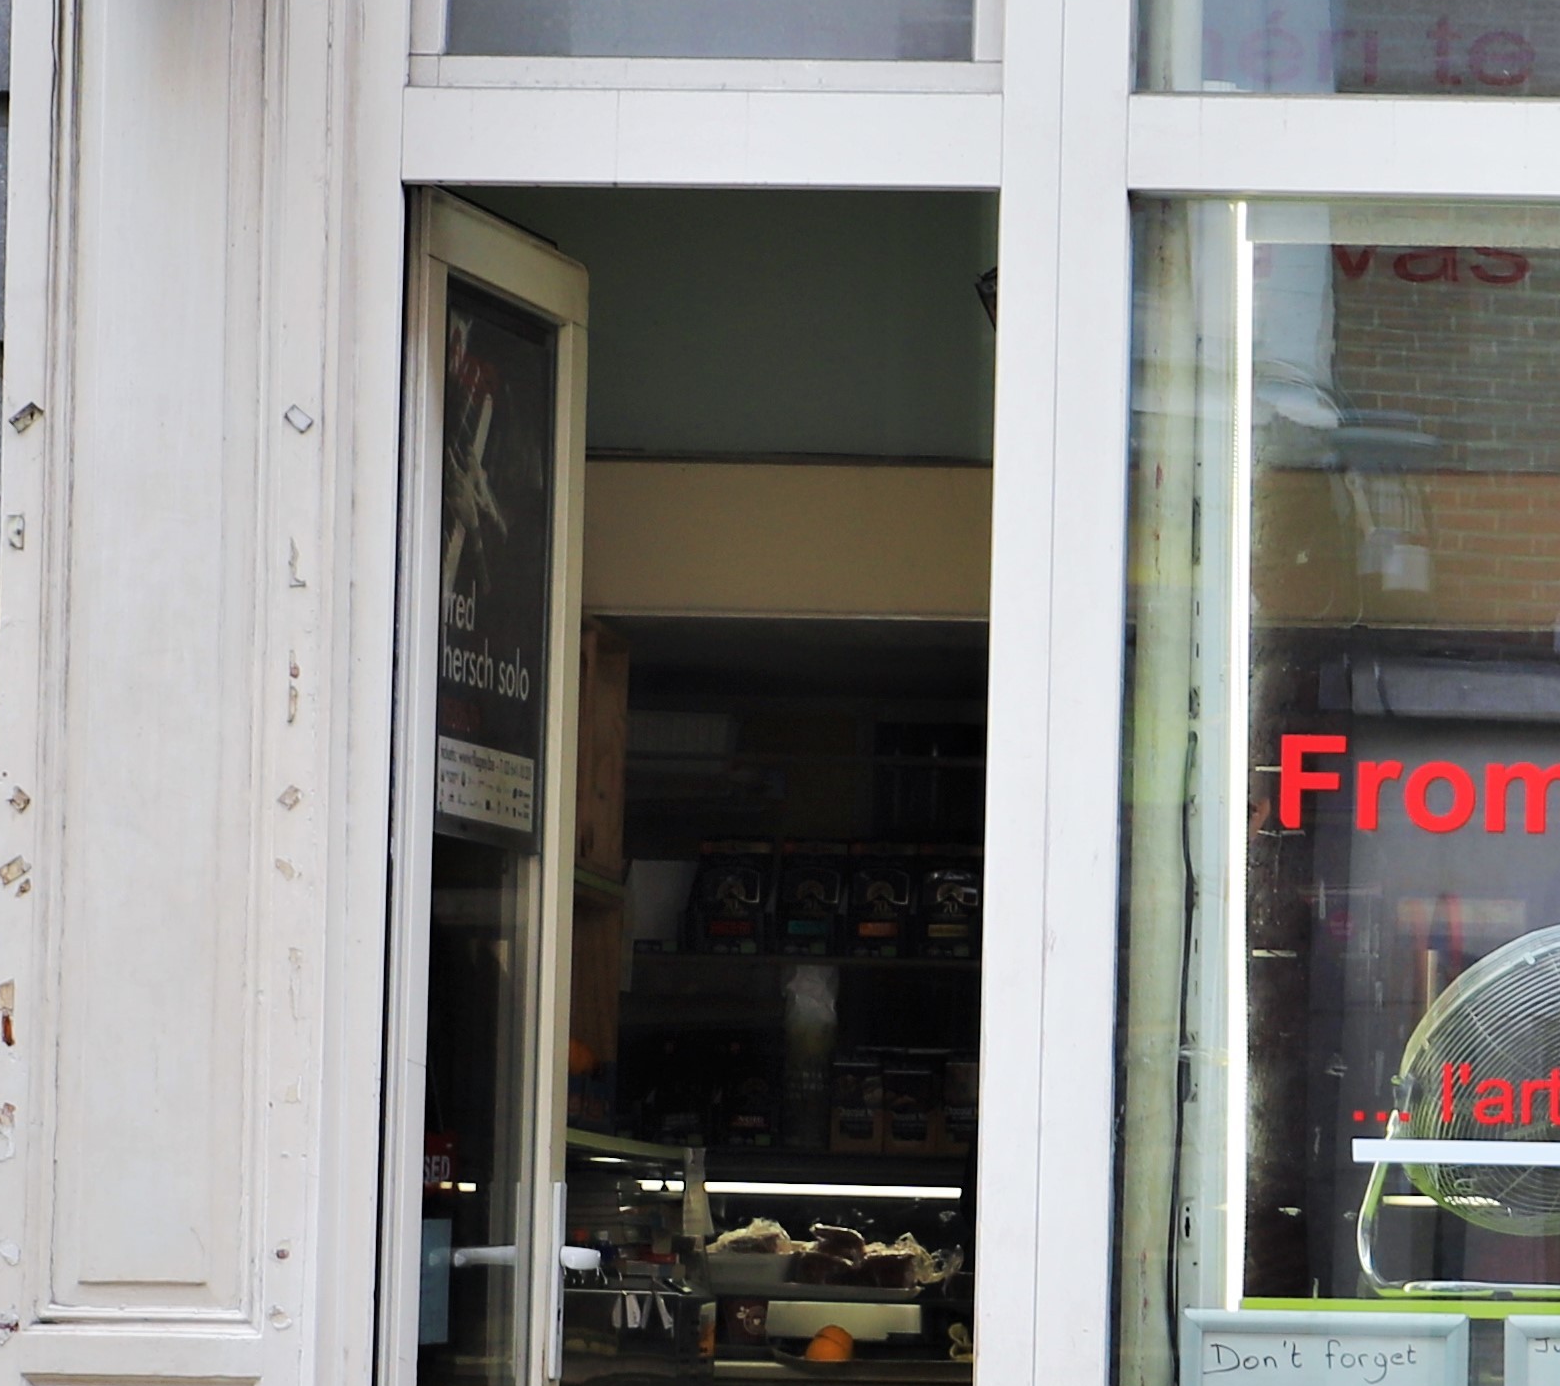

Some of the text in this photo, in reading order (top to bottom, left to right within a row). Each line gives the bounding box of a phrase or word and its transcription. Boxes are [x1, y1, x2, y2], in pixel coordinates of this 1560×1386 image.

[499, 648, 529, 701] solo
[1202, 1339, 1418, 1384] Don't forget
